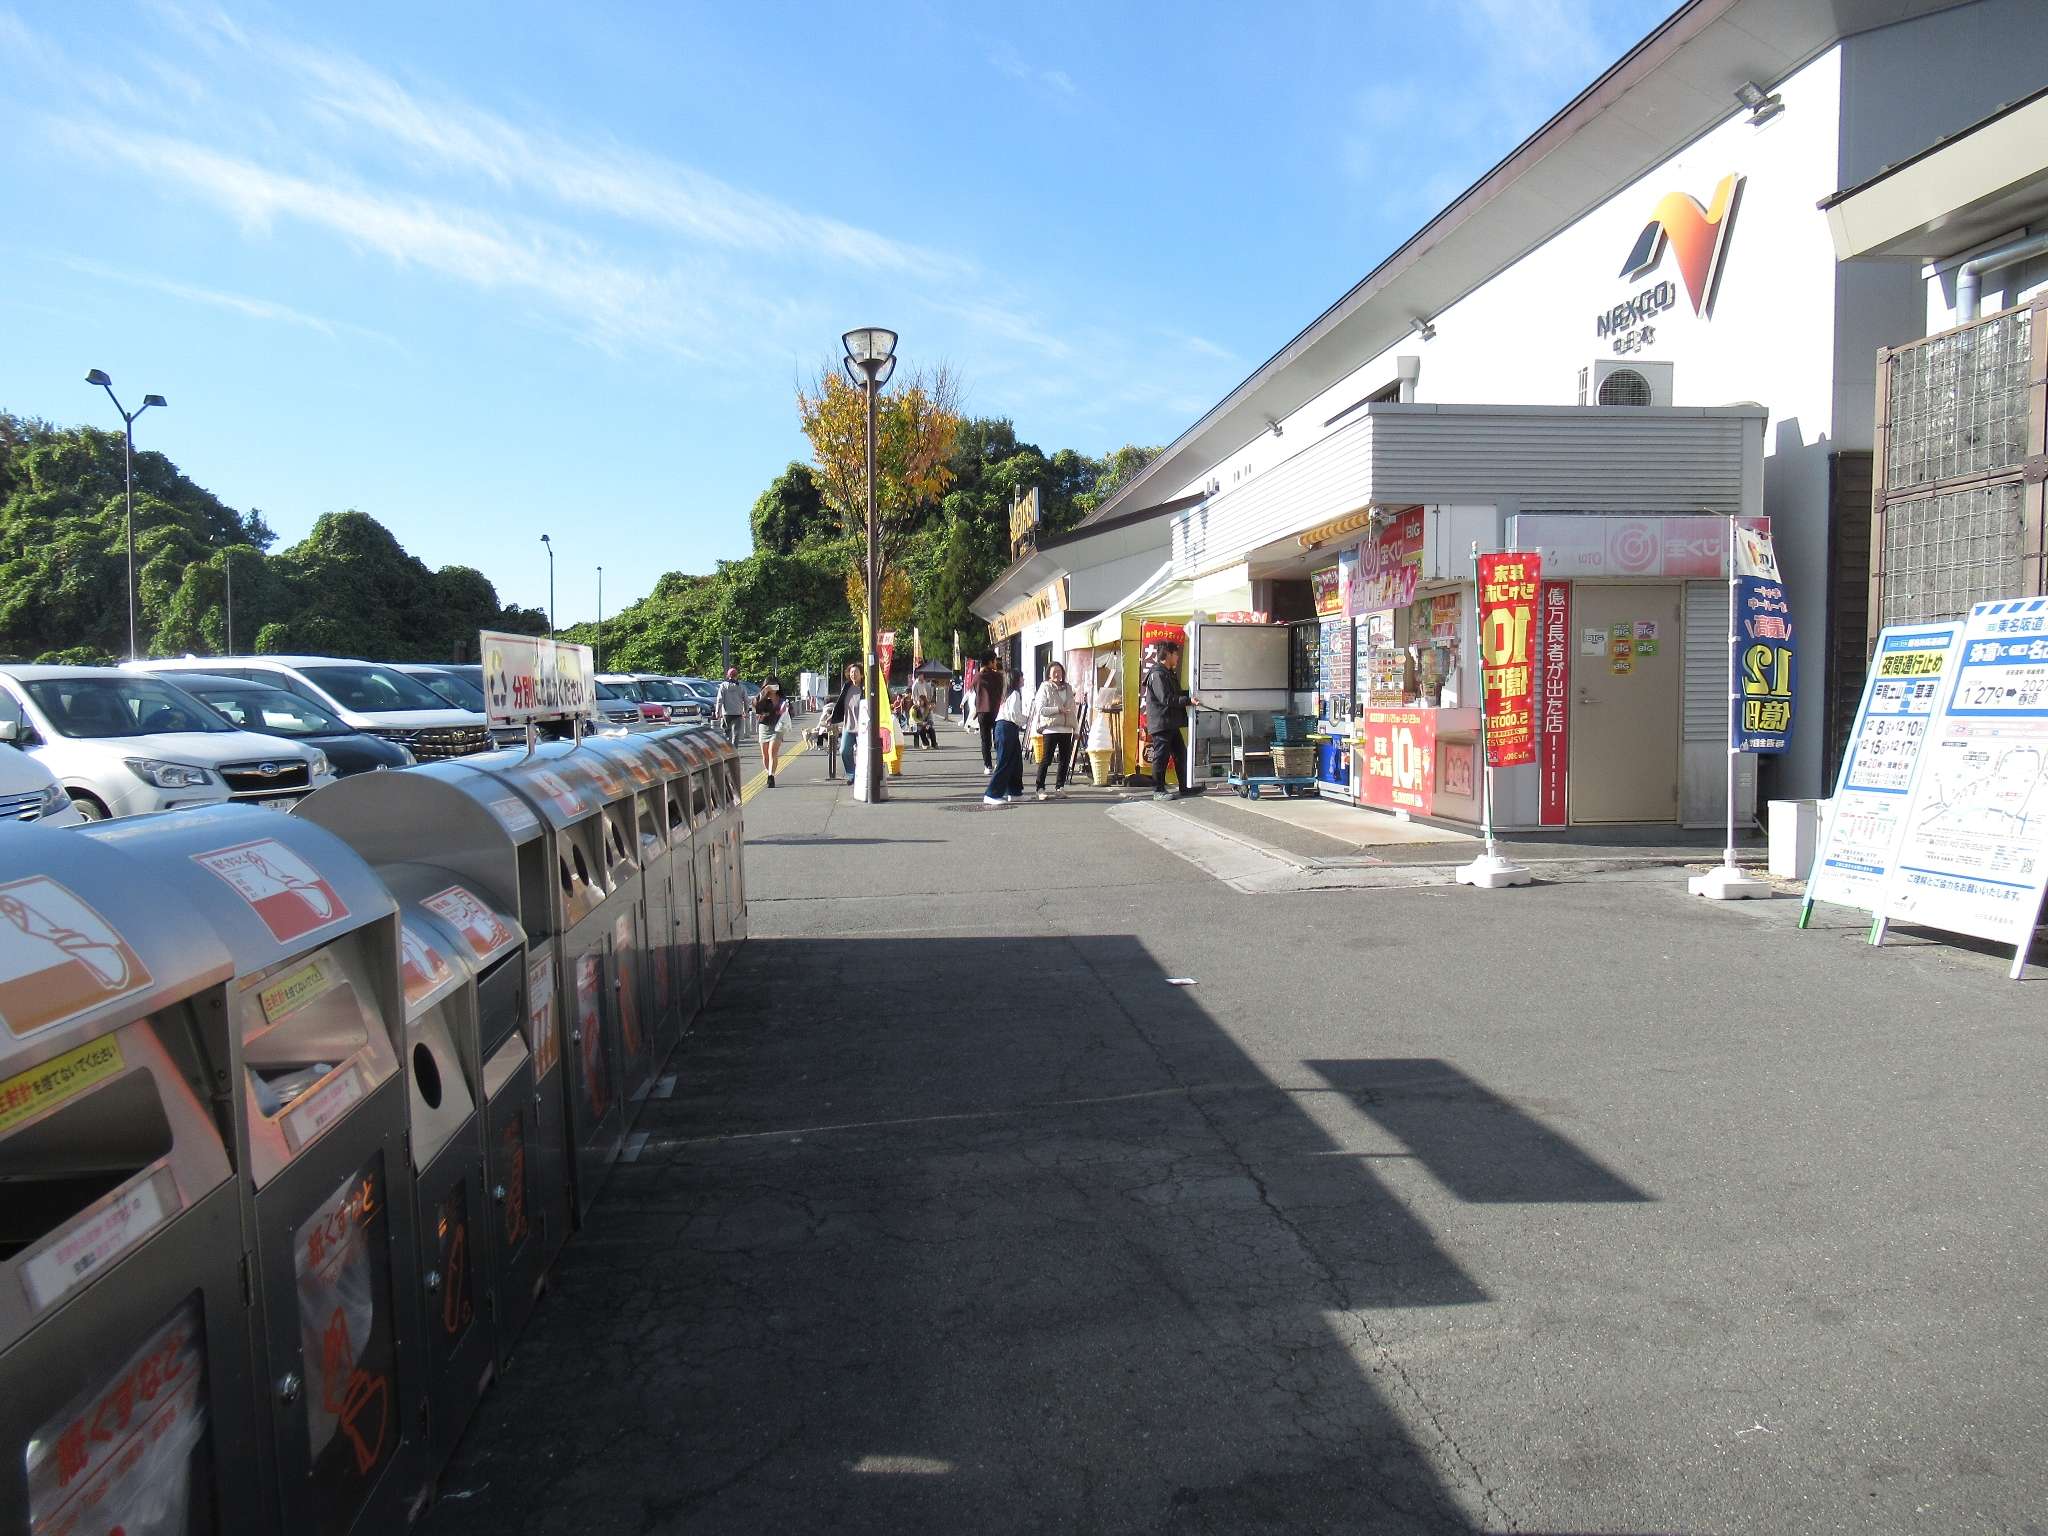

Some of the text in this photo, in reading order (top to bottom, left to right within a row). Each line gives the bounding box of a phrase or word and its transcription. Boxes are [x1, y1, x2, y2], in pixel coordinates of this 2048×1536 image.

[1597, 281, 1674, 338] NEXCO
[1882, 653, 1943, 674] 夜間通行止め
